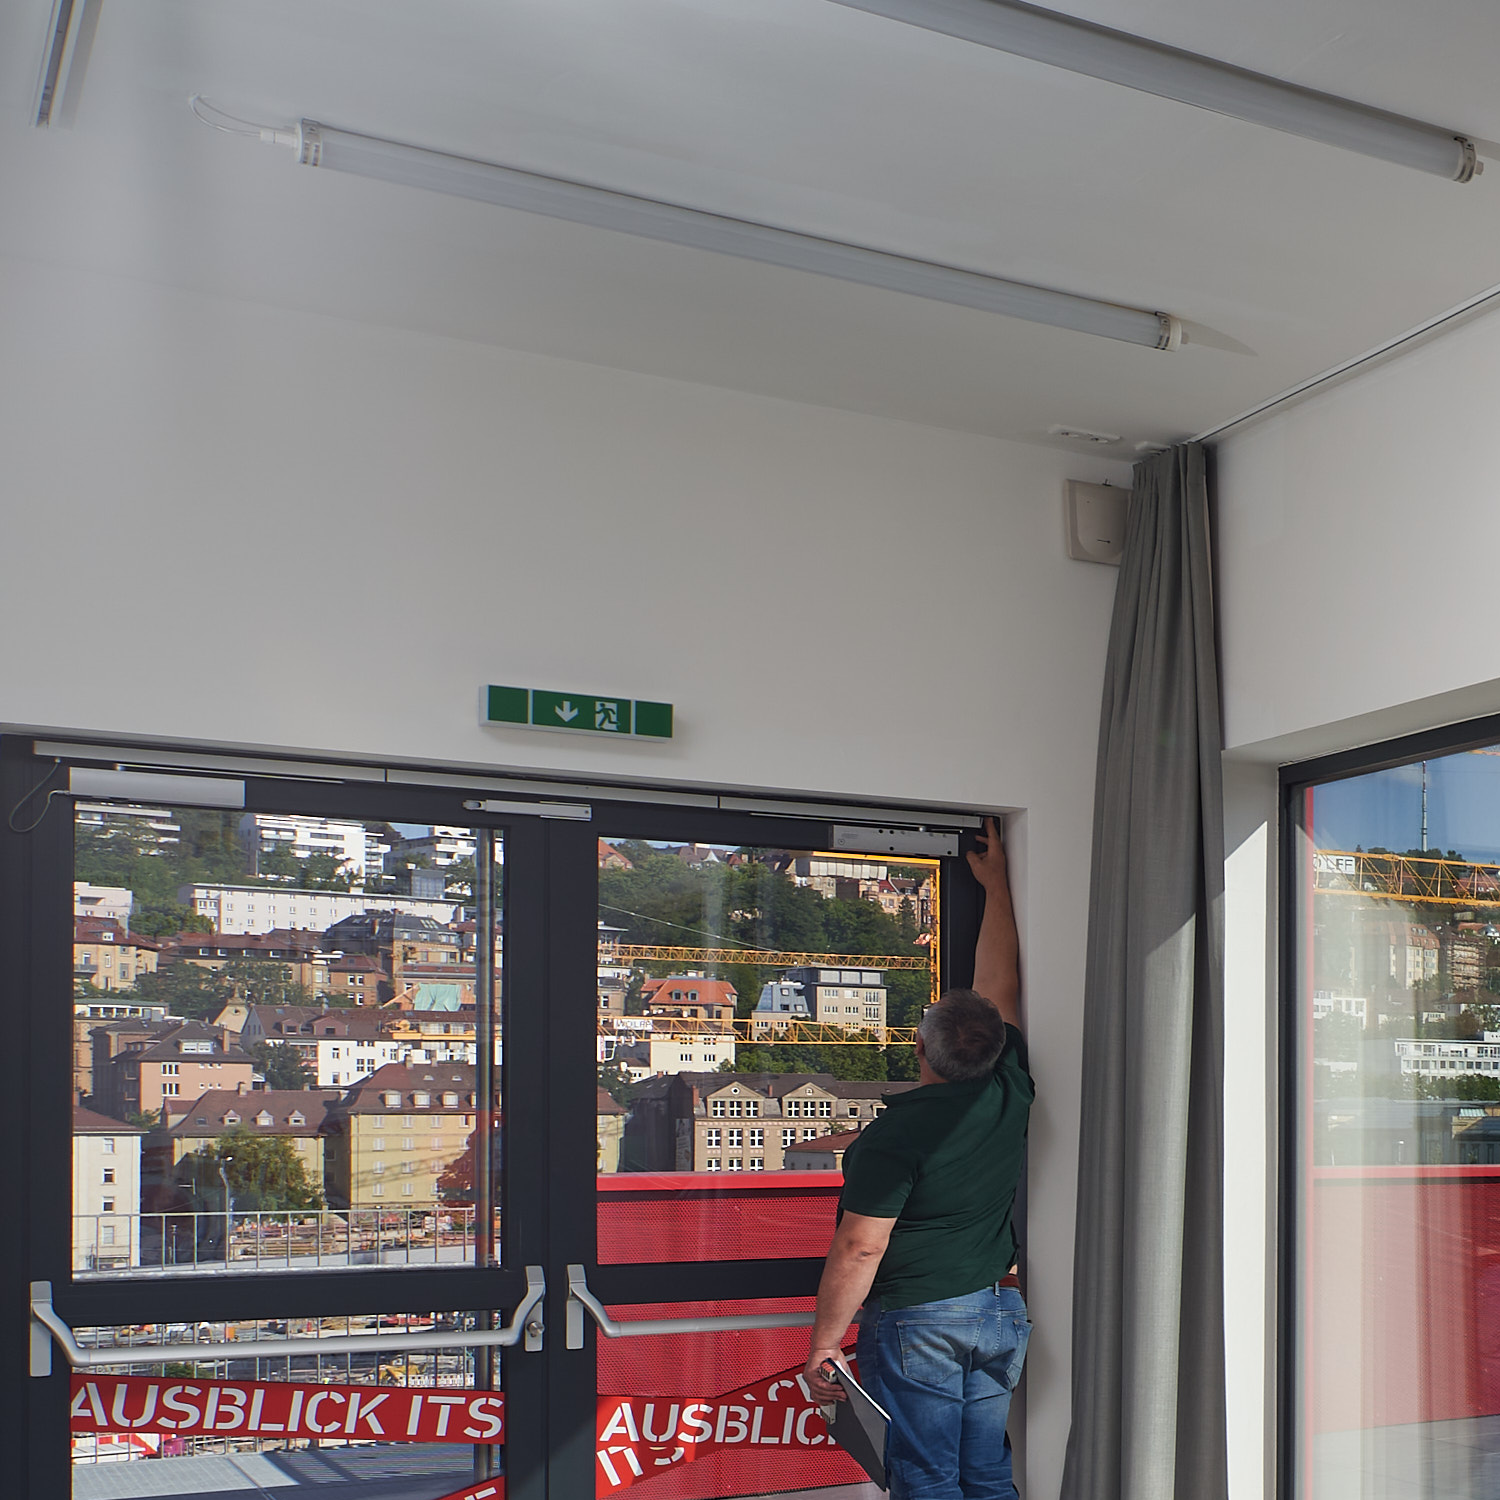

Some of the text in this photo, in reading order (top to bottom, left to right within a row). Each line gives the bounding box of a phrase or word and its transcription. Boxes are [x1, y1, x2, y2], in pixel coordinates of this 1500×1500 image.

[71, 1382, 504, 1438] AUSBLICK ITS
[599, 1402, 837, 1445] AUSBLIC
